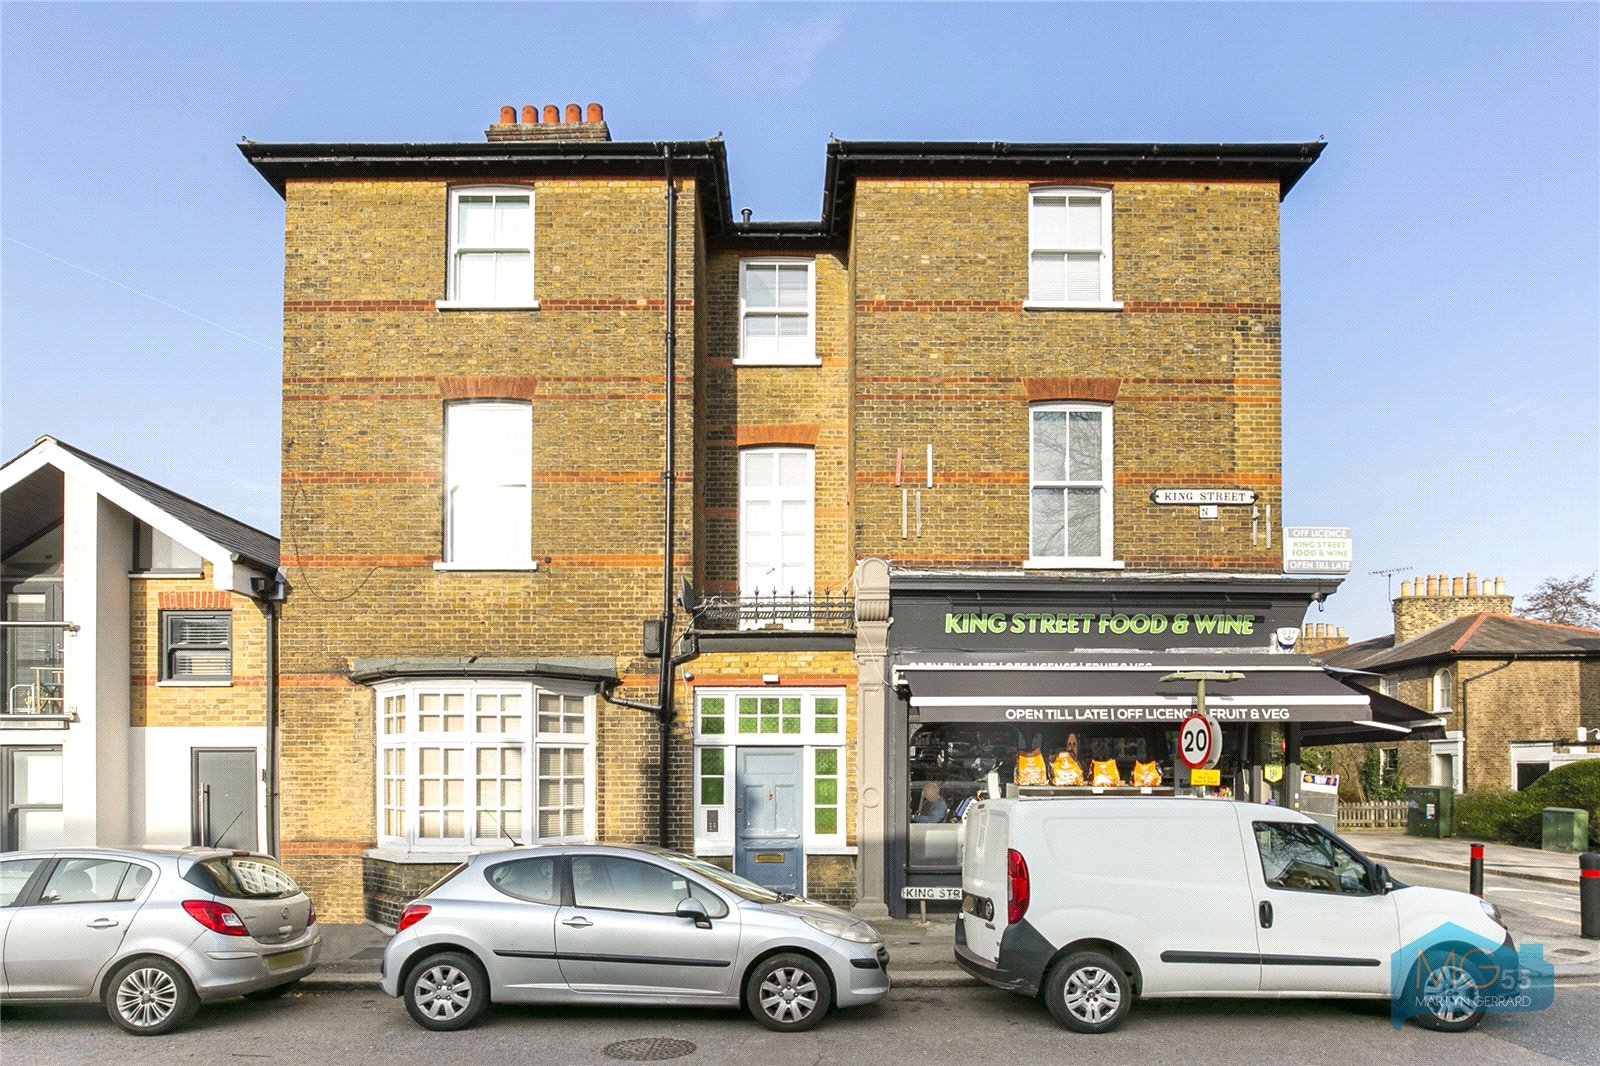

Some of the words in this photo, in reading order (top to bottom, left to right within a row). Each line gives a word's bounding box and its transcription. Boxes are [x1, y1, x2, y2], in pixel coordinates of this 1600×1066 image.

[1164, 492, 1193, 501] KING
[1200, 492, 1246, 502] STREET
[1202, 507, 1208, 516] N
[1293, 529, 1308, 538] OFF
[1311, 530, 1347, 538] LICENCE
[1317, 541, 1346, 549] STREET
[1290, 561, 1313, 569] OPEN
[1315, 561, 1330, 569] TILL
[1332, 561, 1350, 569] LATE
[945, 613, 1007, 634] KING
[1010, 613, 1095, 634] STREET
[1098, 613, 1168, 634] FOOD
[1171, 614, 1189, 634] &
[1194, 614, 1255, 635] WINE
[1005, 708, 1043, 719] OPEN
[1045, 709, 1073, 719] TILL
[1075, 709, 1109, 719] LATE
[1117, 708, 1143, 719] OFF
[1209, 708, 1248, 719] FRUIT
[1250, 709, 1260, 719] &
[1261, 708, 1290, 719] VEG
[1184, 729, 1207, 752] 20
[906, 888, 934, 898] KING
